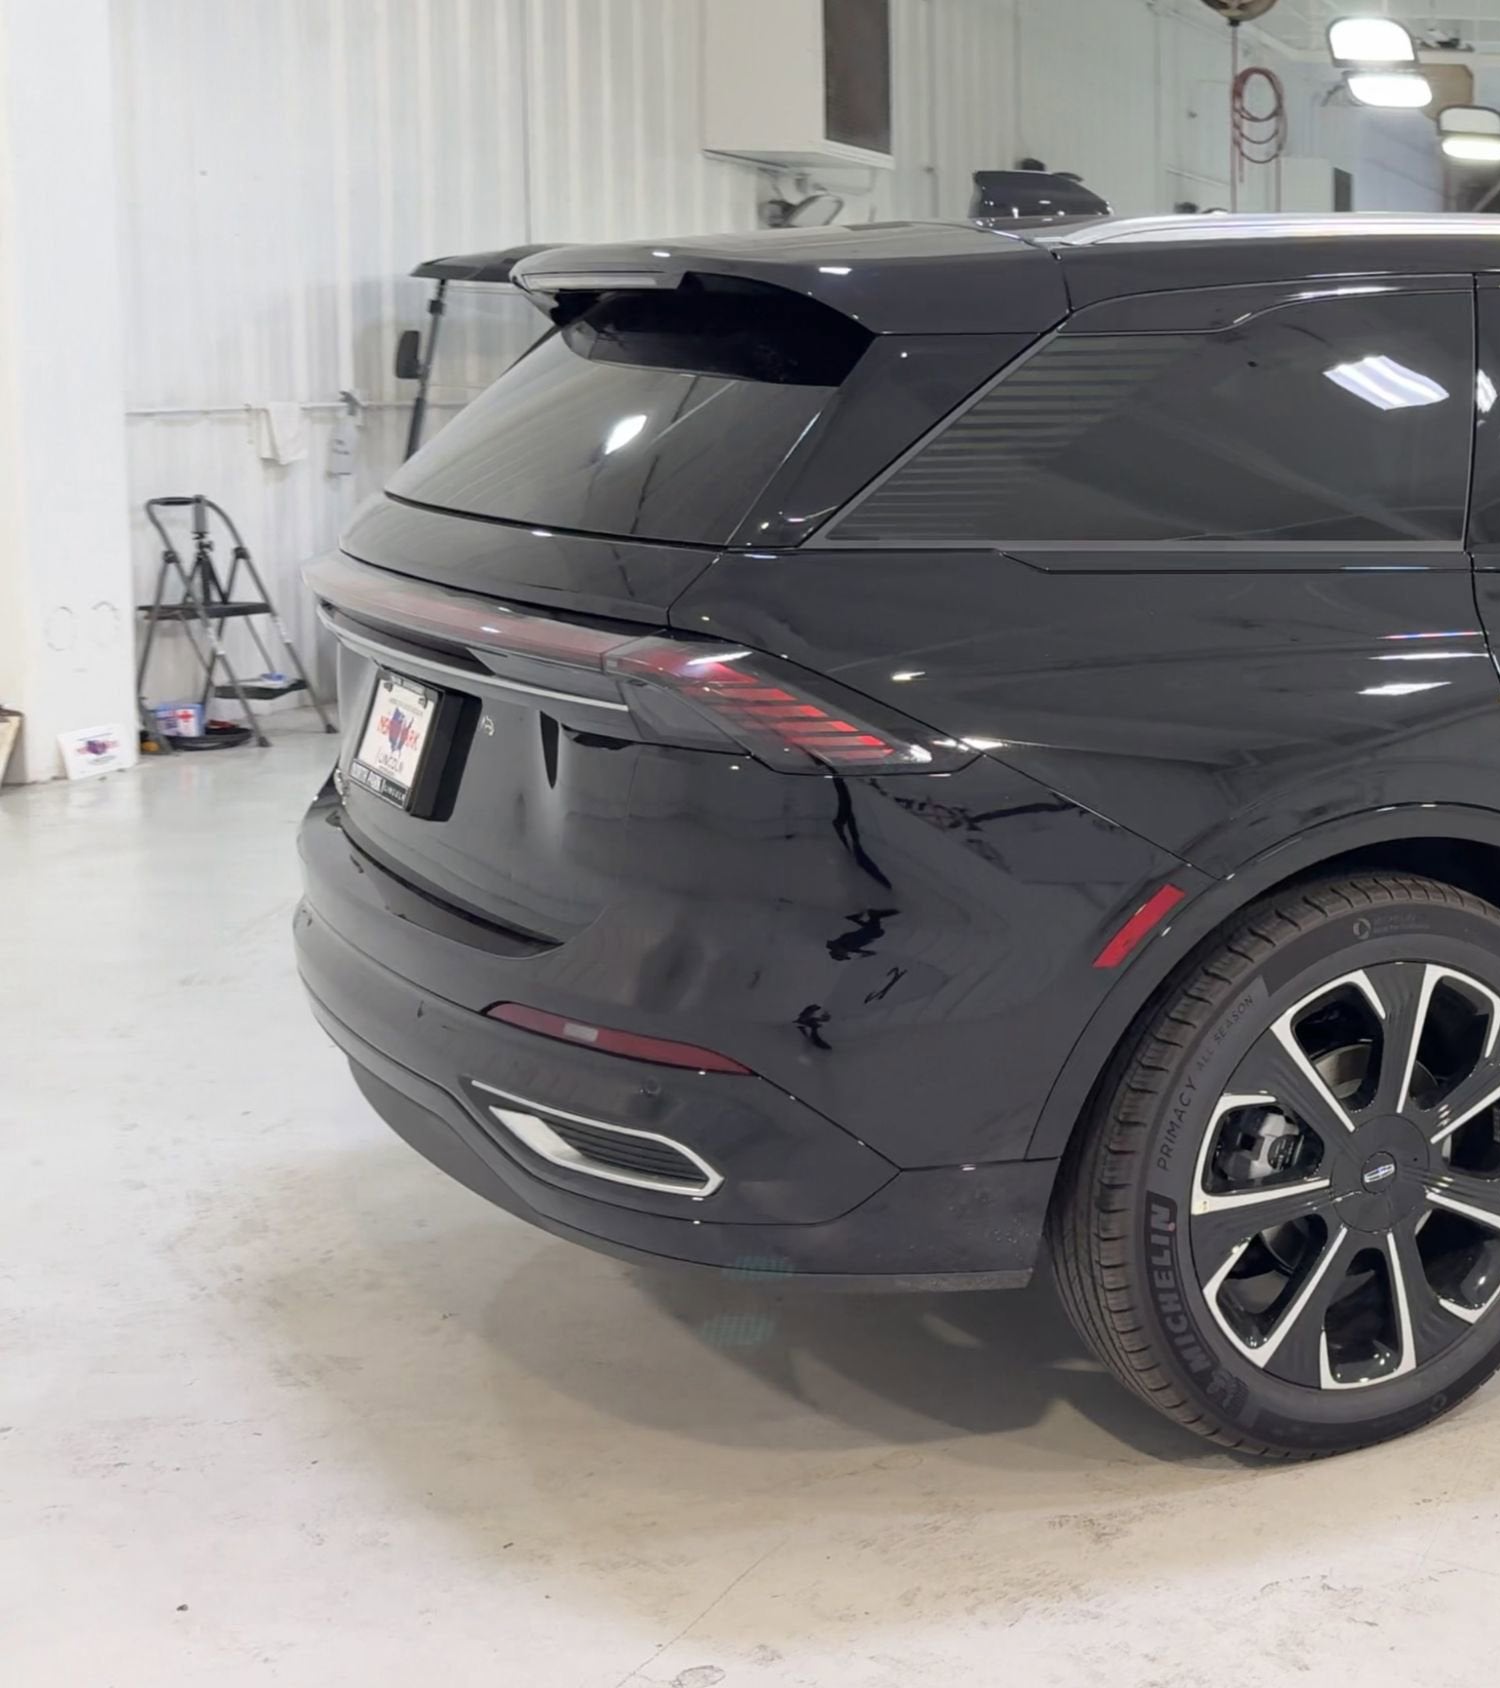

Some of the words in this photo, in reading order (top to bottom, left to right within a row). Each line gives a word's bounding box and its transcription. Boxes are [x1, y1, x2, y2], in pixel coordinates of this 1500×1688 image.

[1157, 1075, 1197, 1172] PRIMACY
[1196, 1050, 1214, 1071] ALL
[1213, 995, 1254, 1045] SEASON
[1151, 1203, 1212, 1374] MICHELIN
